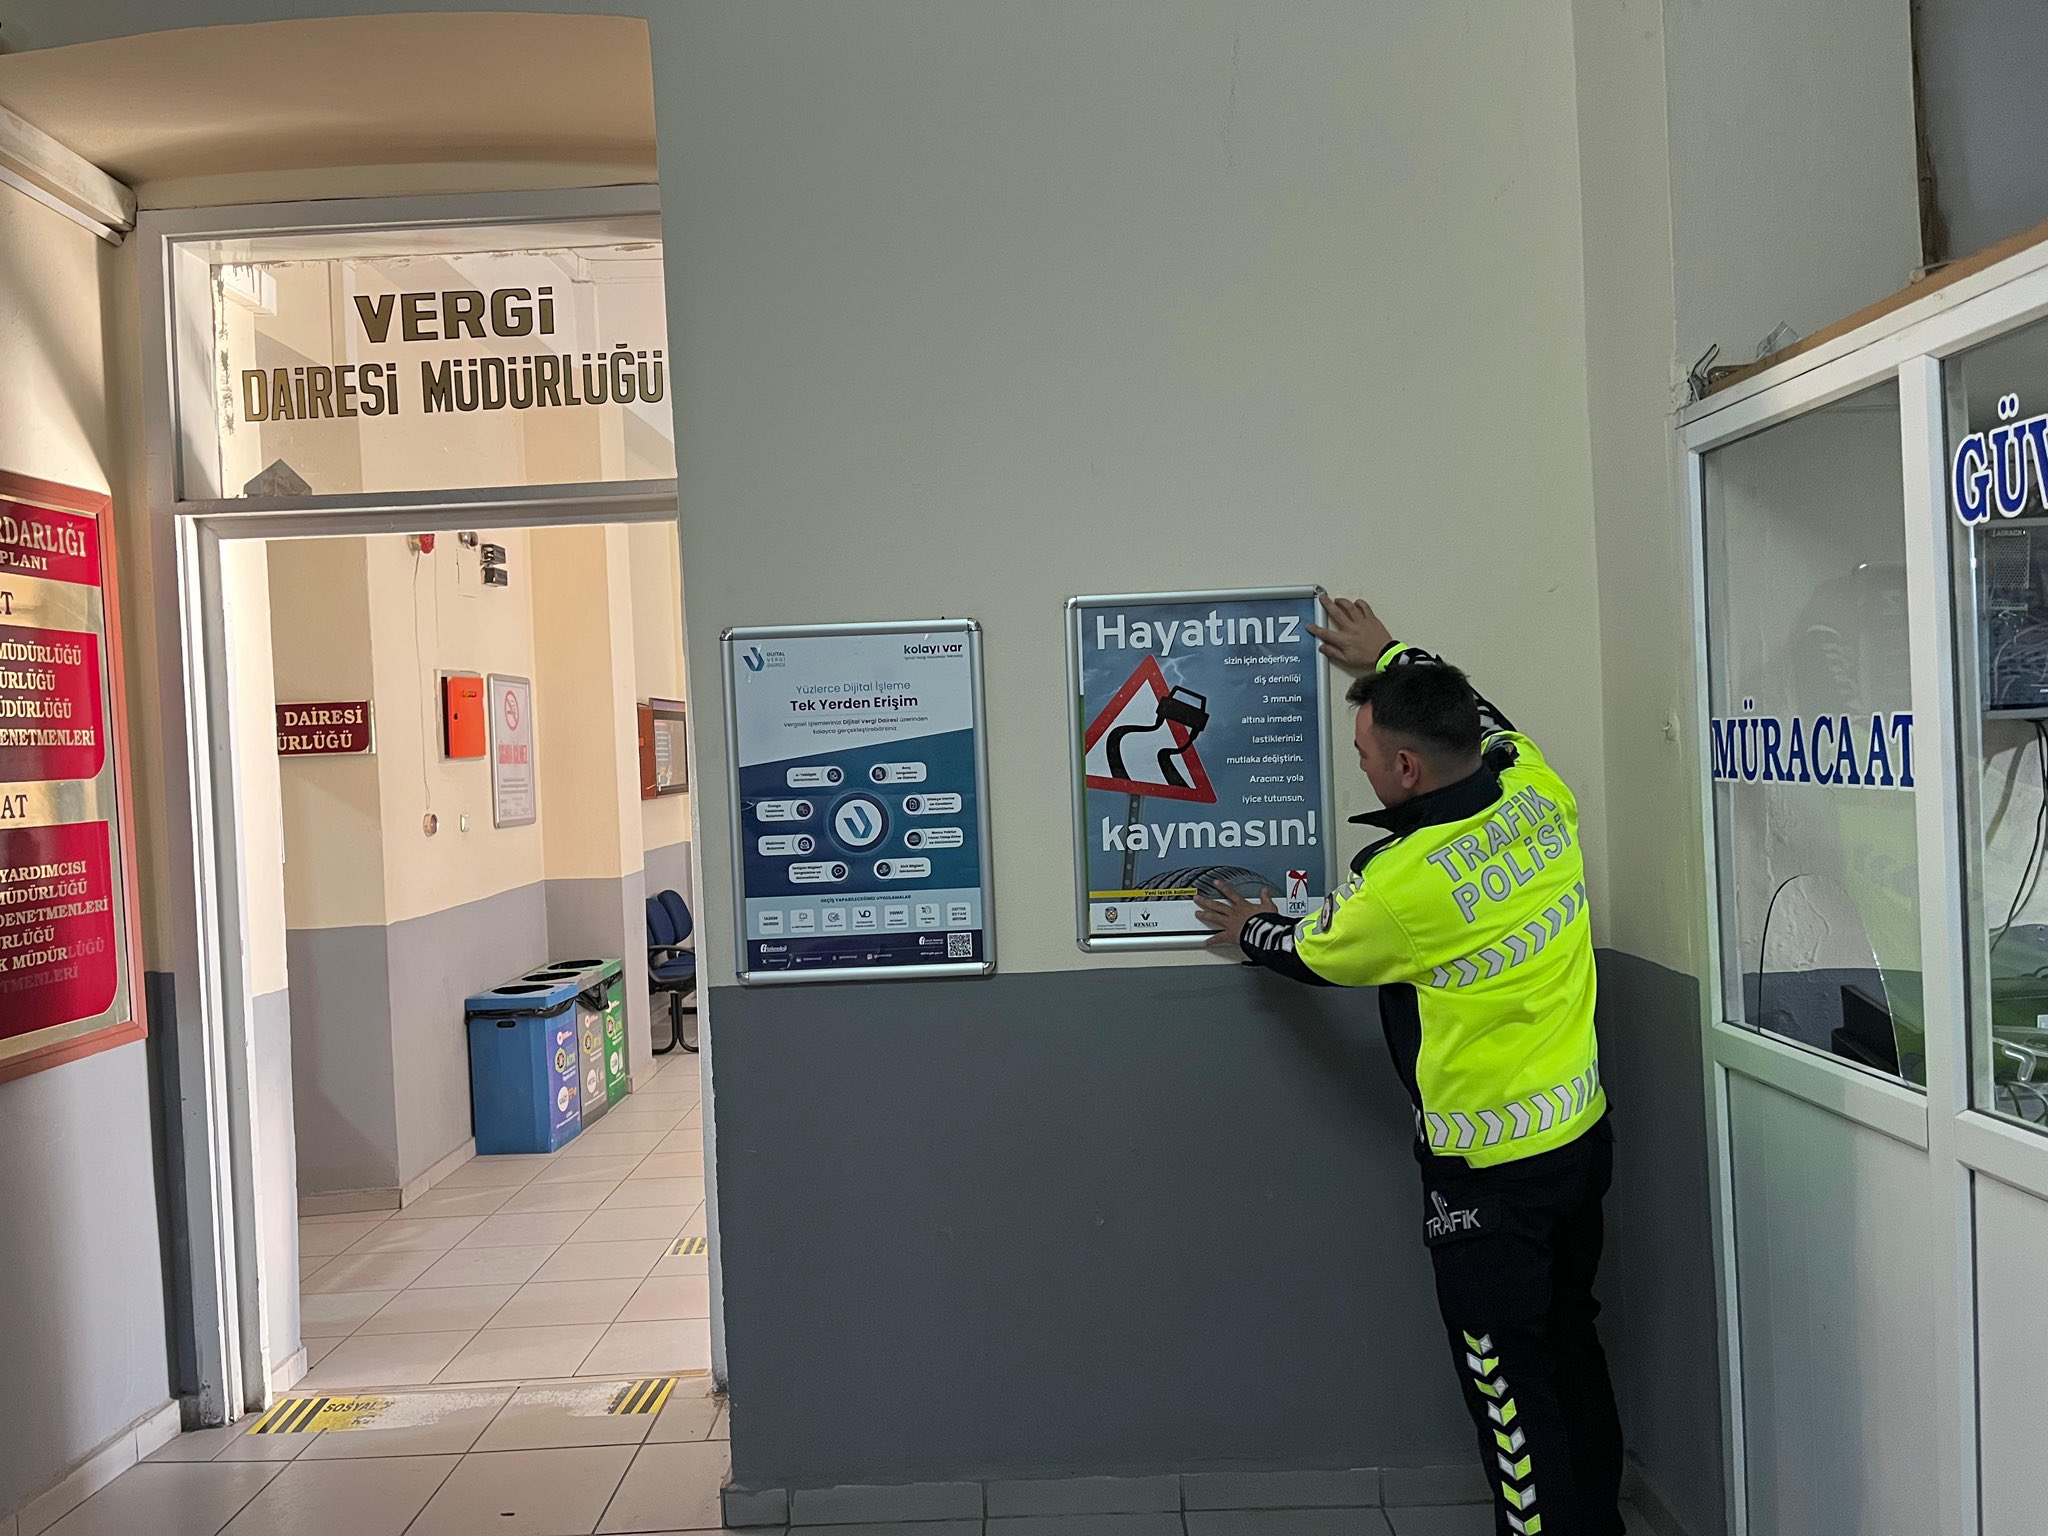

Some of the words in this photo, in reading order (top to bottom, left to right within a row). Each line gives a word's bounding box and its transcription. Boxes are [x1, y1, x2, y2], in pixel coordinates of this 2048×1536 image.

[421, 343, 664, 413] MÜDÜRLÜĞÜ
[1096, 609, 1301, 657] Hayatınız
[903, 644, 940, 655] kolayı
[942, 644, 963, 653] var
[1243, 656, 1258, 667] için
[1258, 654, 1301, 666] değerliyse,
[1254, 674, 1267, 685] diş
[1269, 672, 1301, 684] derinliği
[795, 684, 841, 695] Yüzlerce
[843, 682, 873, 695] Dijital
[875, 681, 911, 693] İşleme
[789, 700, 816, 712] Tek
[818, 698, 871, 711] Yerden
[874, 695, 918, 711] Erişim
[1262, 695, 1269, 703] 3
[285, 705, 363, 727] DAİRESİ
[1241, 715, 1265, 724] altına
[1267, 714, 1302, 723] inmeden
[1252, 733, 1303, 744] lastiklerinizi
[1712, 698, 1914, 788] MÜRACAAT
[1226, 754, 1261, 764] mutlaka
[1262, 752, 1304, 764] değiştirin.
[1250, 773, 1285, 784] Aracınız
[1286, 774, 1304, 784] yola
[1242, 795, 1261, 805] iyice
[1102, 810, 1318, 858] kaymasın!
[0, 861, 87, 883] YARDIMCISI
[0, 925, 55, 950] RLÜĞÜ
